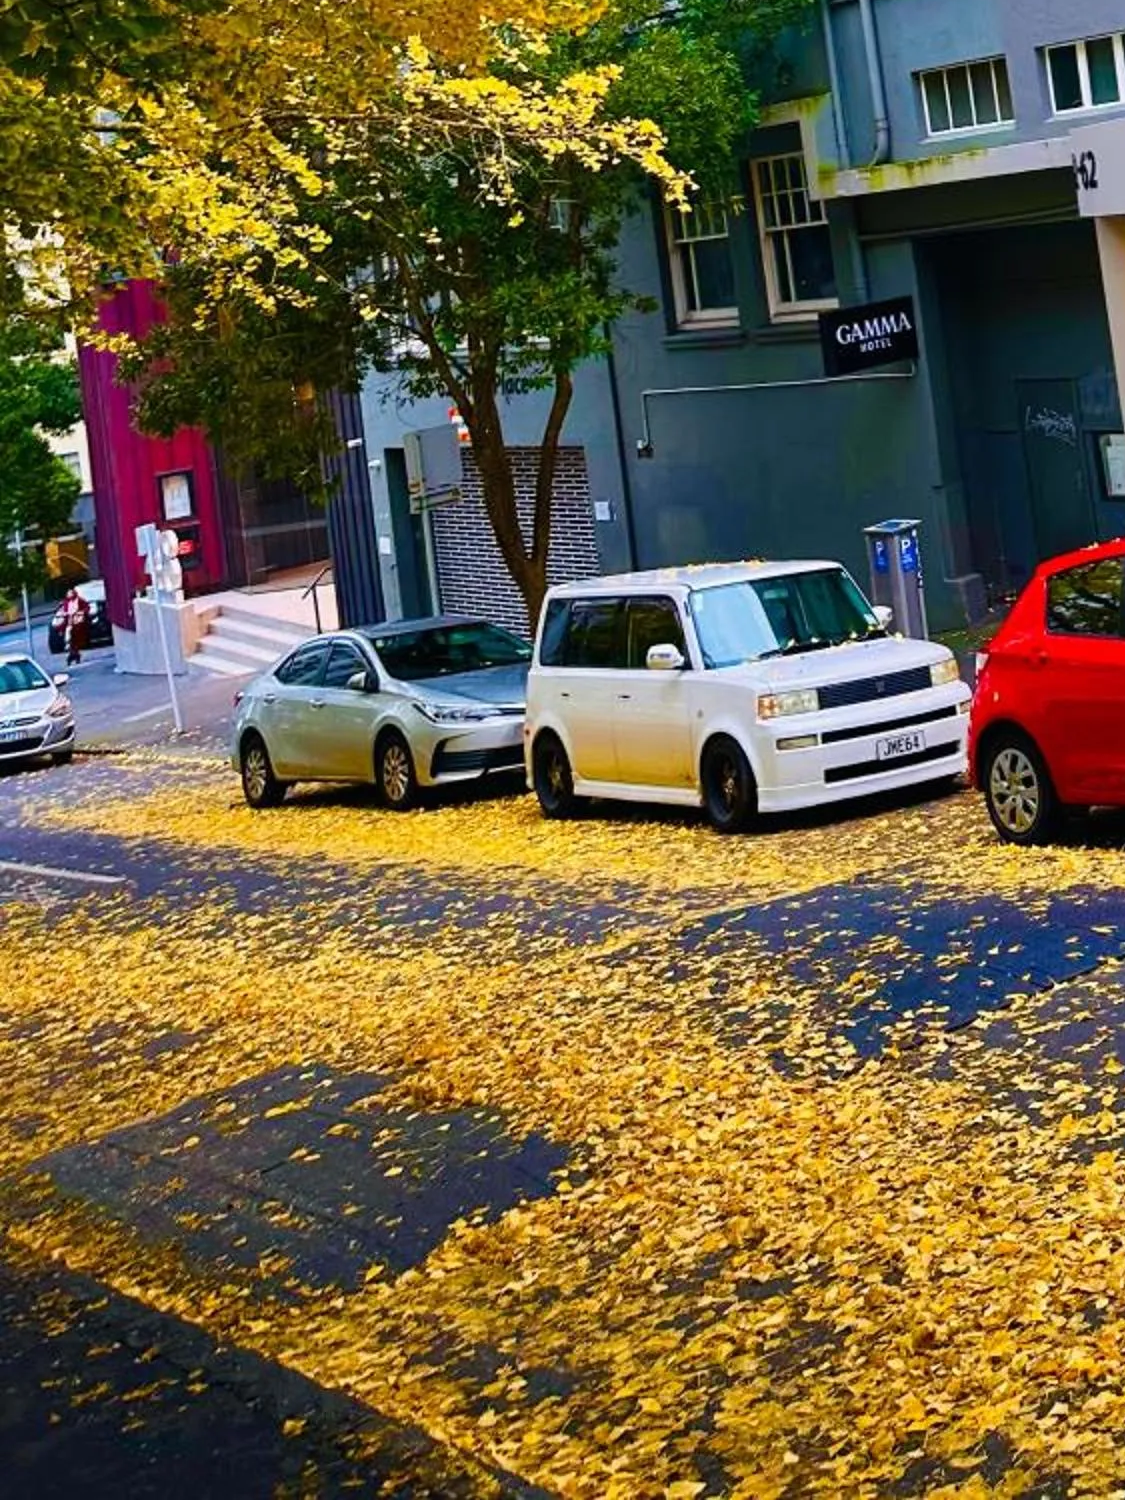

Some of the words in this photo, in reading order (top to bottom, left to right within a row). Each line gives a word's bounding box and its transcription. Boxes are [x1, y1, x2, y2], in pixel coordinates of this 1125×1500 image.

[836, 311, 912, 345] GAMMA
[860, 337, 892, 352] HOTEL
[901, 539, 911, 555] P
